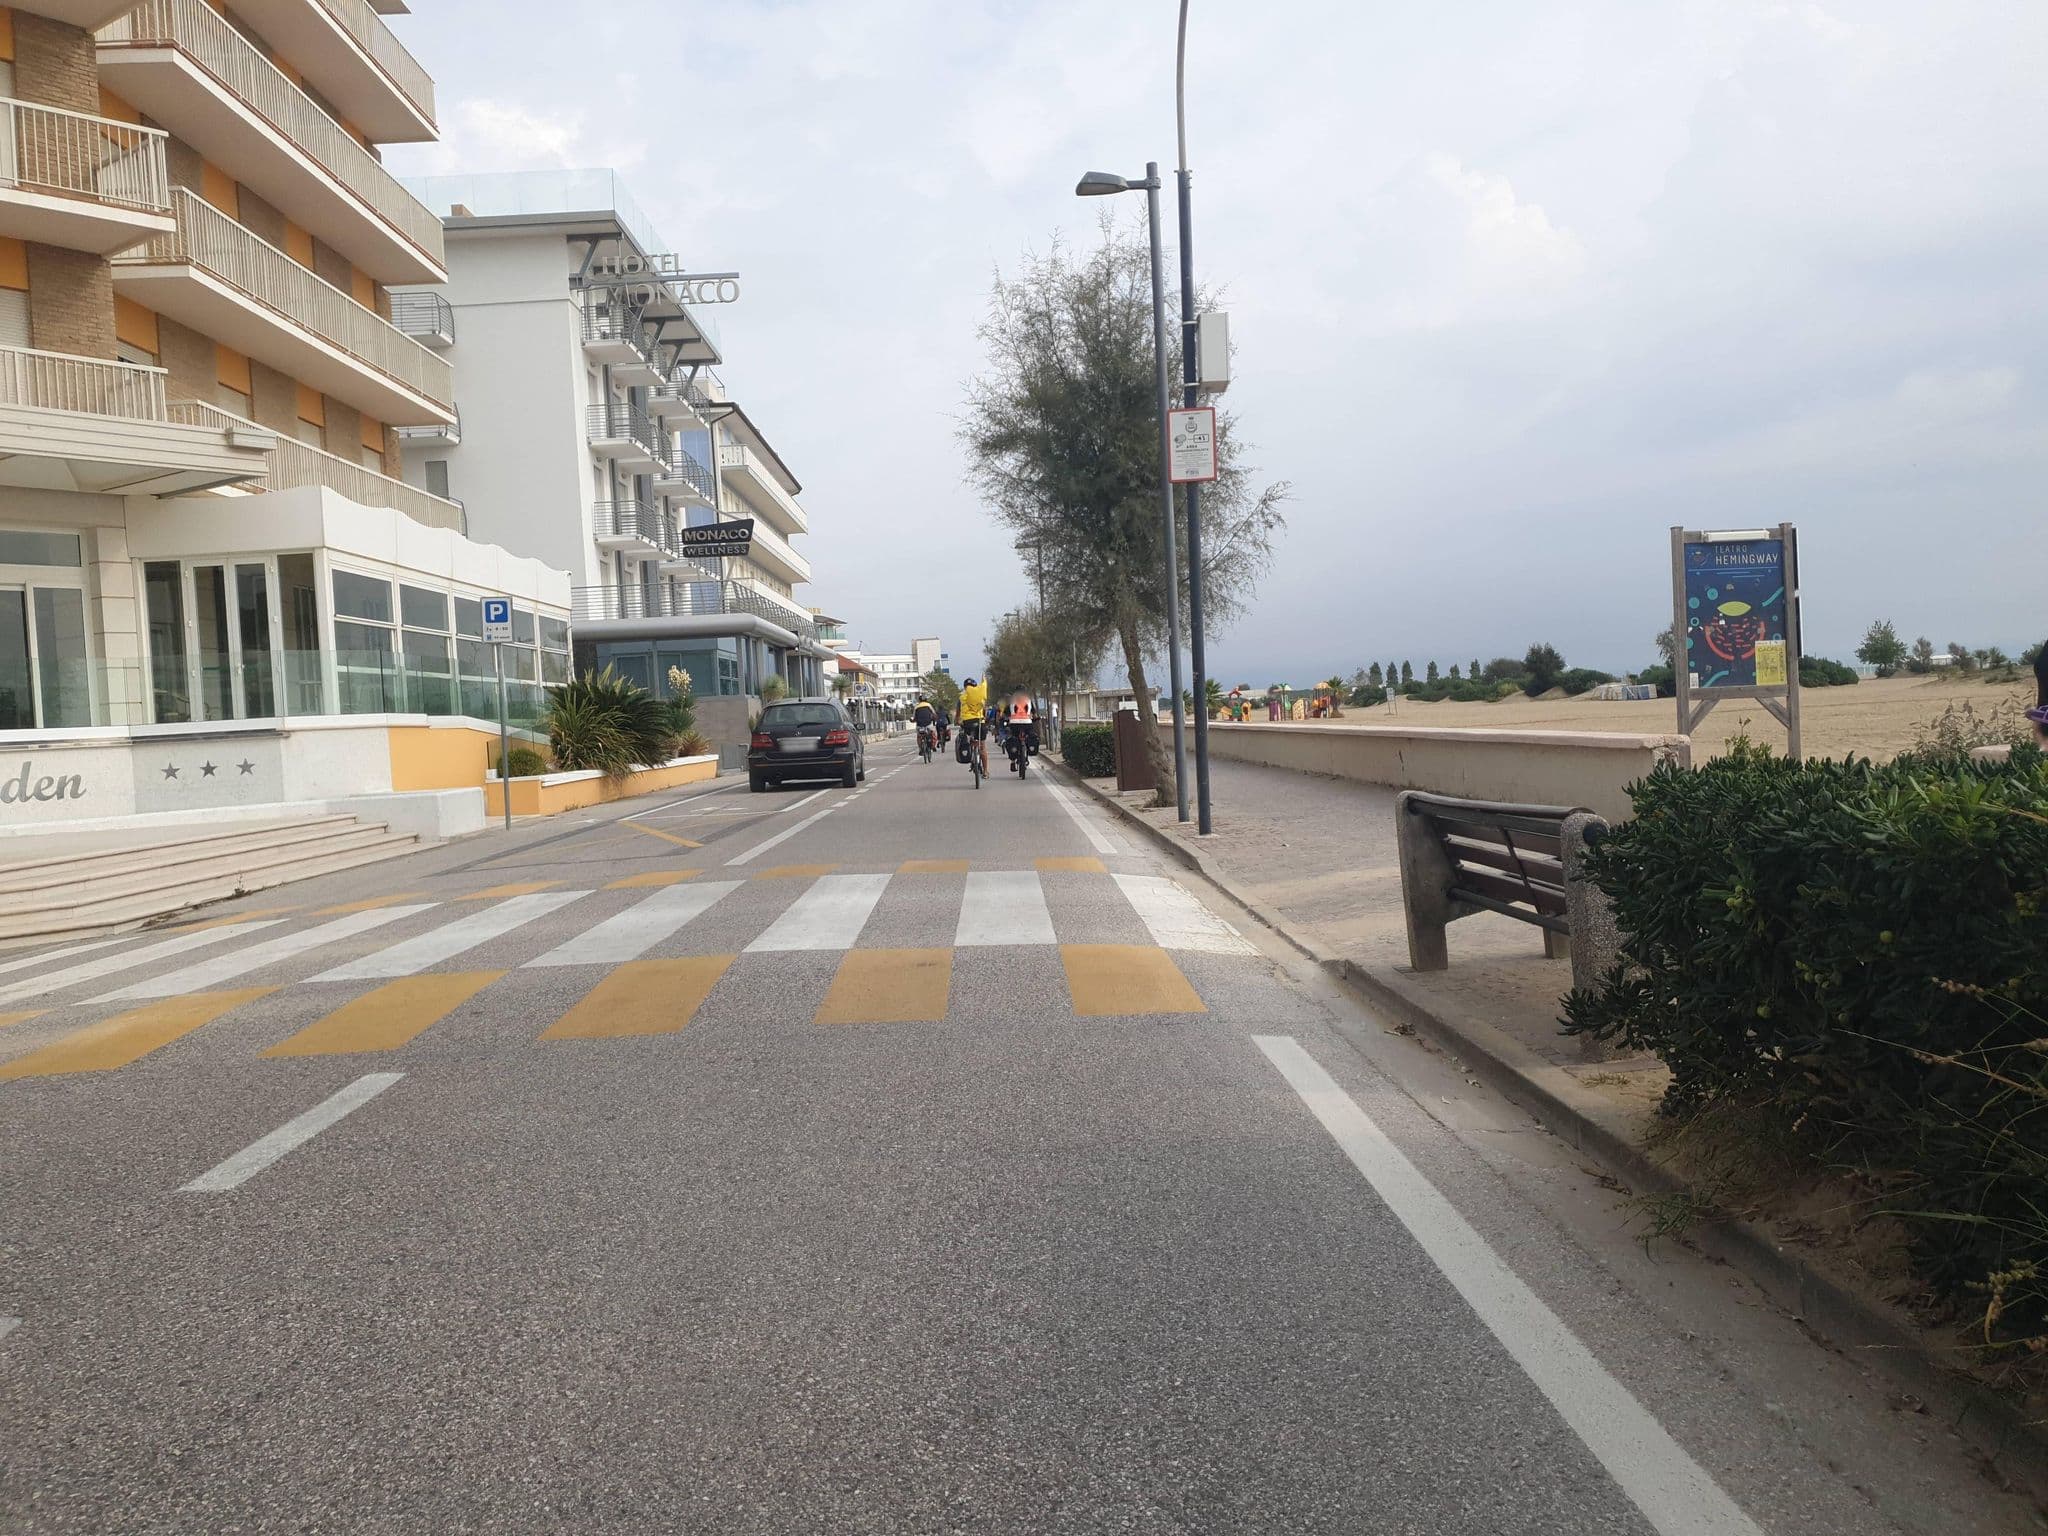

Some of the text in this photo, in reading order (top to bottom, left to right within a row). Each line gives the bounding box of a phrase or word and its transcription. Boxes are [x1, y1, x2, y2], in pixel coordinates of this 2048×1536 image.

[602, 253, 685, 275] HOTEL
[606, 279, 740, 308] MONACO
[684, 528, 750, 542] MONACO
[686, 545, 747, 556] WELLNESS
[1715, 544, 1748, 554] TEATRO
[1715, 553, 1779, 566] HEMINGWAY
[490, 603, 504, 621] P
